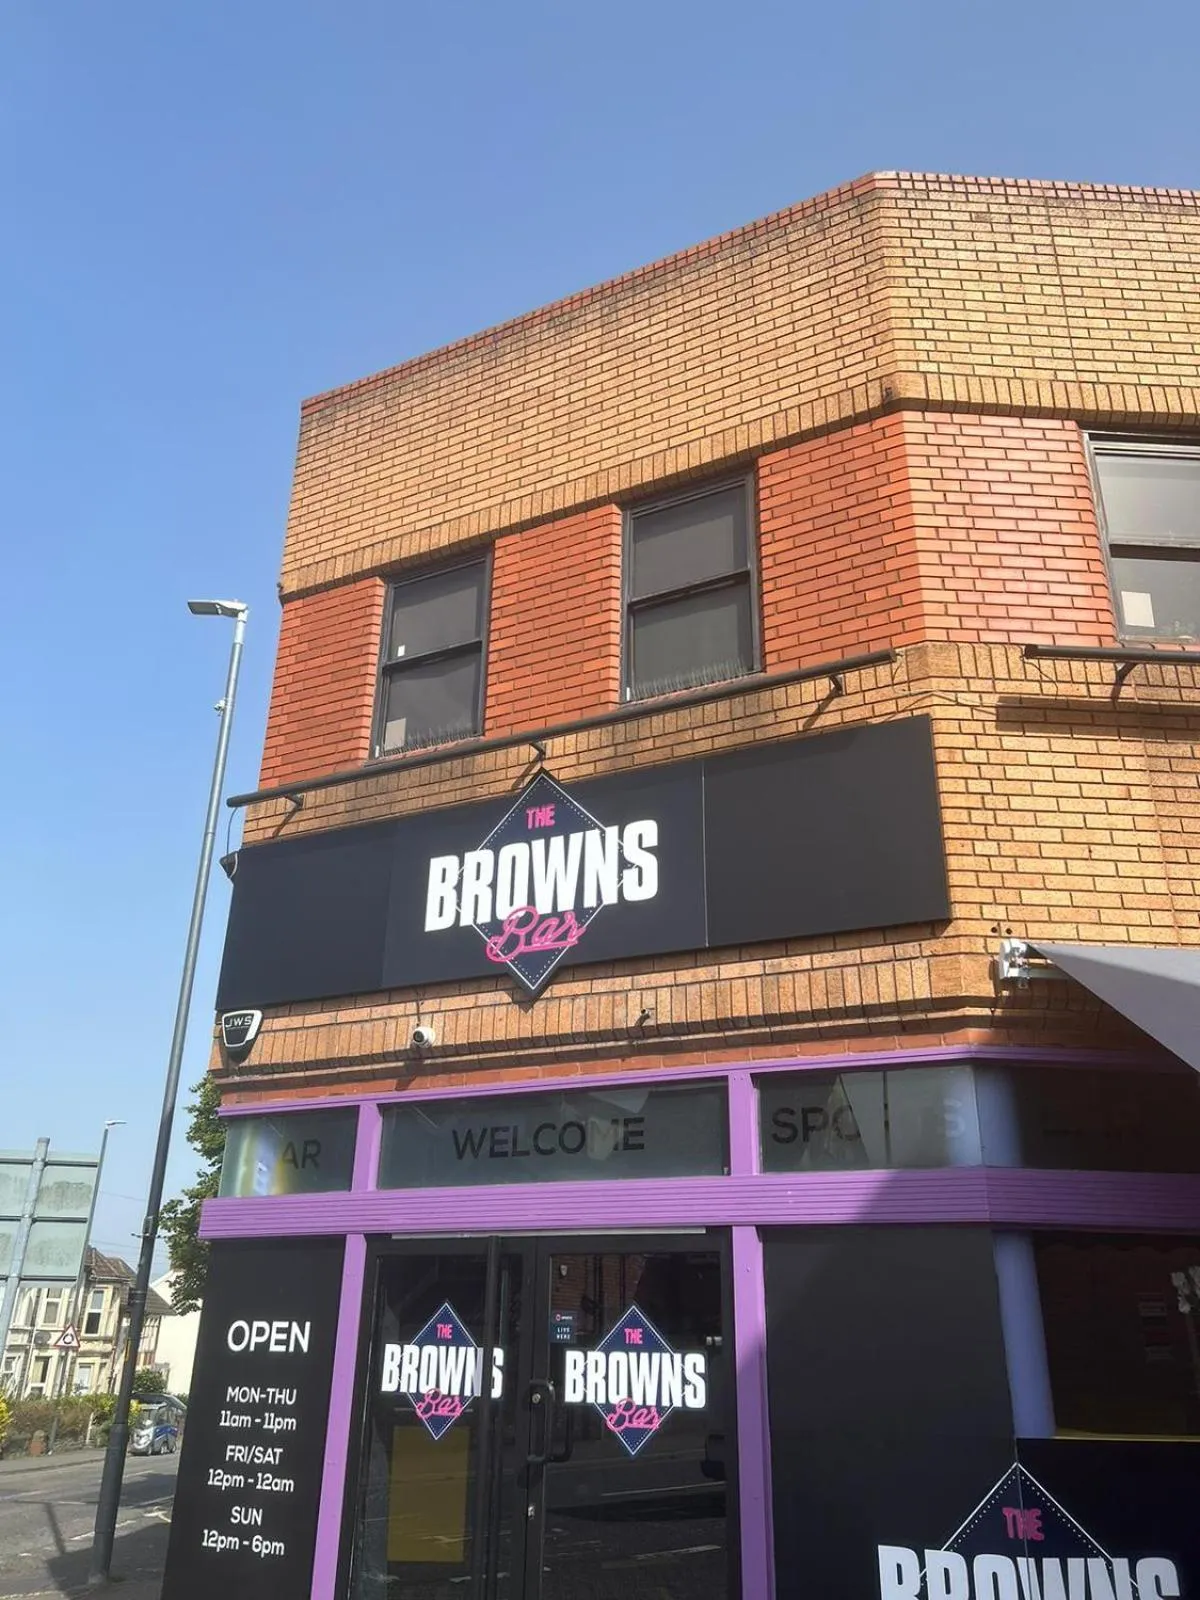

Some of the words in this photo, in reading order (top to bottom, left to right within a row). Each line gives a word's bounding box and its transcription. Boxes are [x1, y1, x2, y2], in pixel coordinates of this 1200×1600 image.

[525, 803, 556, 829] THE
[424, 819, 659, 932] BROWNS
[485, 905, 587, 963] Bar
[225, 1016, 252, 1028] JWS
[226, 1319, 311, 1353] OPEN
[436, 1323, 453, 1340] THE
[624, 1328, 643, 1345] THE
[564, 1350, 706, 1409] BROWNS
[226, 1386, 297, 1406] MON-THU
[415, 1388, 464, 1419] Bar
[219, 1410, 252, 1428] 11am
[262, 1412, 297, 1433] 11pm
[605, 1397, 661, 1432] Bar
[225, 1445, 284, 1465] FRI/SAT
[207, 1469, 244, 1490] 12pm
[255, 1472, 295, 1493] 12am
[230, 1506, 263, 1526] SUN
[1001, 1506, 1045, 1542] THE
[201, 1529, 240, 1553] 12pm
[251, 1534, 285, 1557] 6pm
